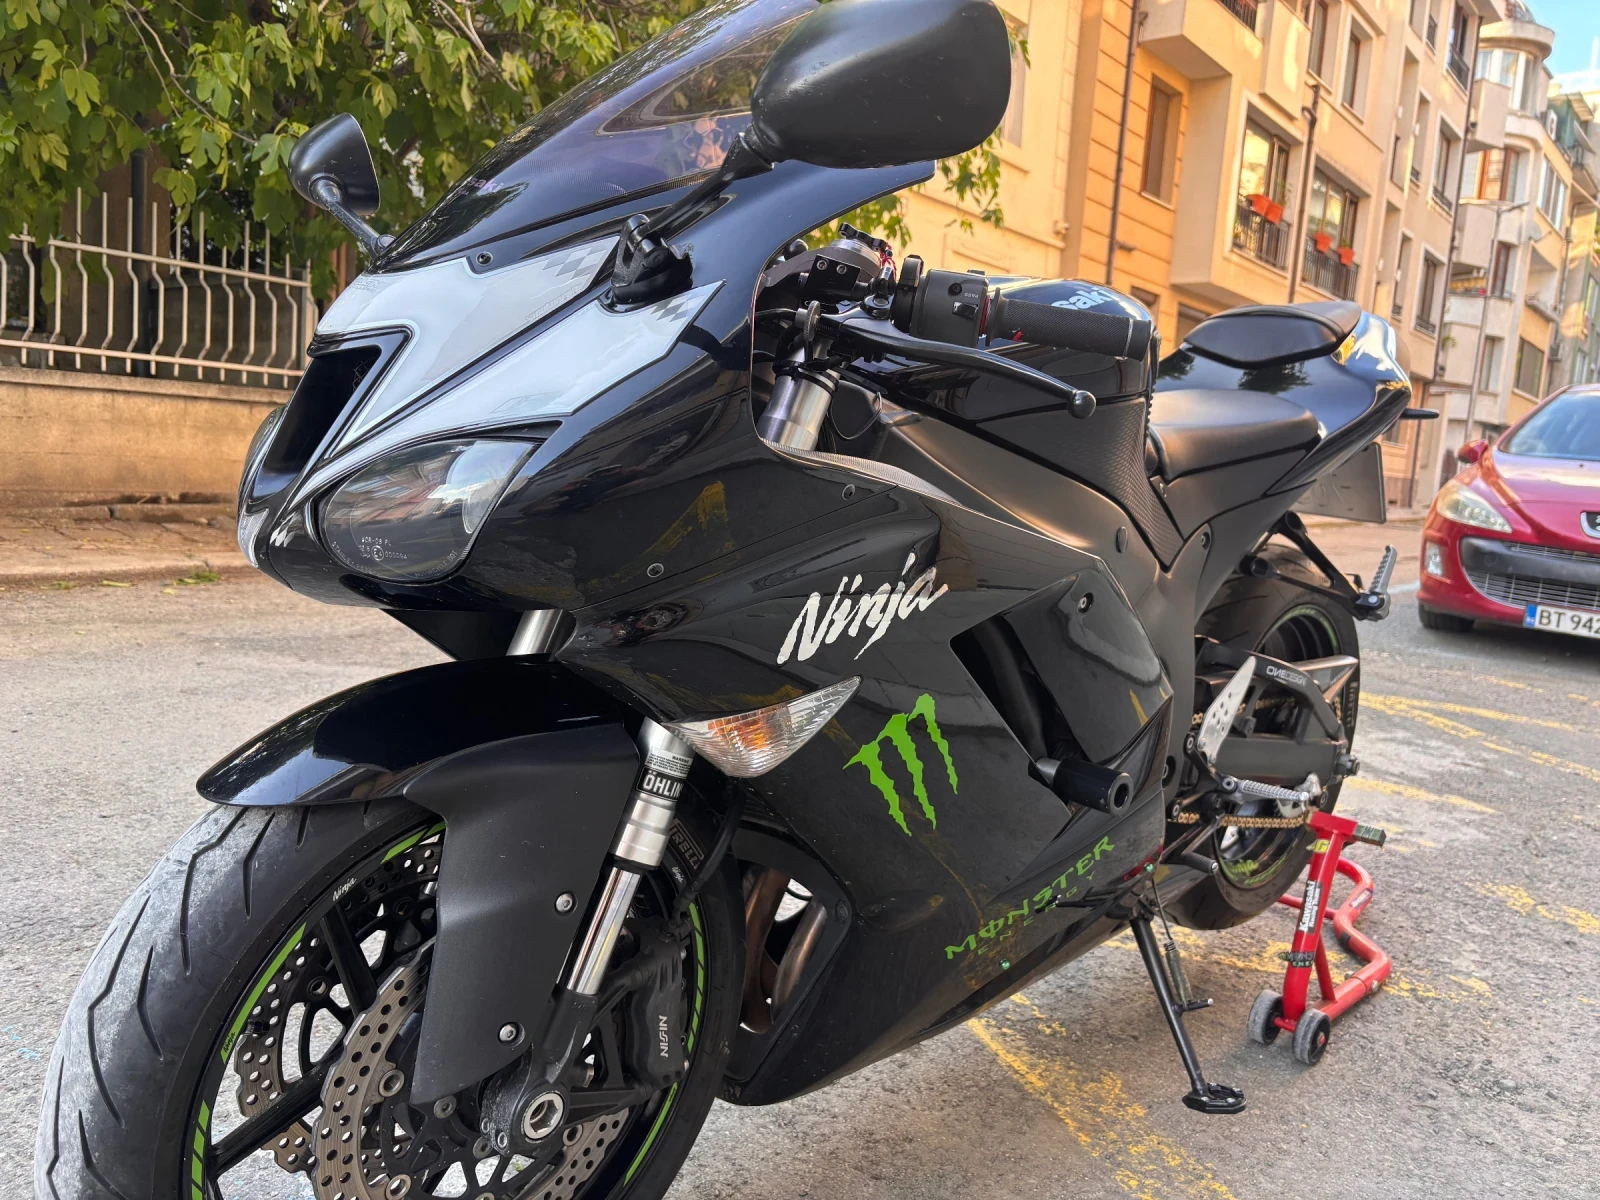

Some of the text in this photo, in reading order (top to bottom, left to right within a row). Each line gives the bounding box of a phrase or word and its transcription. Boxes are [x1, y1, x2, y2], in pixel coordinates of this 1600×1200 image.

[777, 552, 948, 664] Ninja
[1539, 609, 1566, 629] BT
[332, 877, 358, 902] Ninja
[944, 835, 1116, 960] MONSTER
[1299, 880, 1316, 931] Kawasaki
